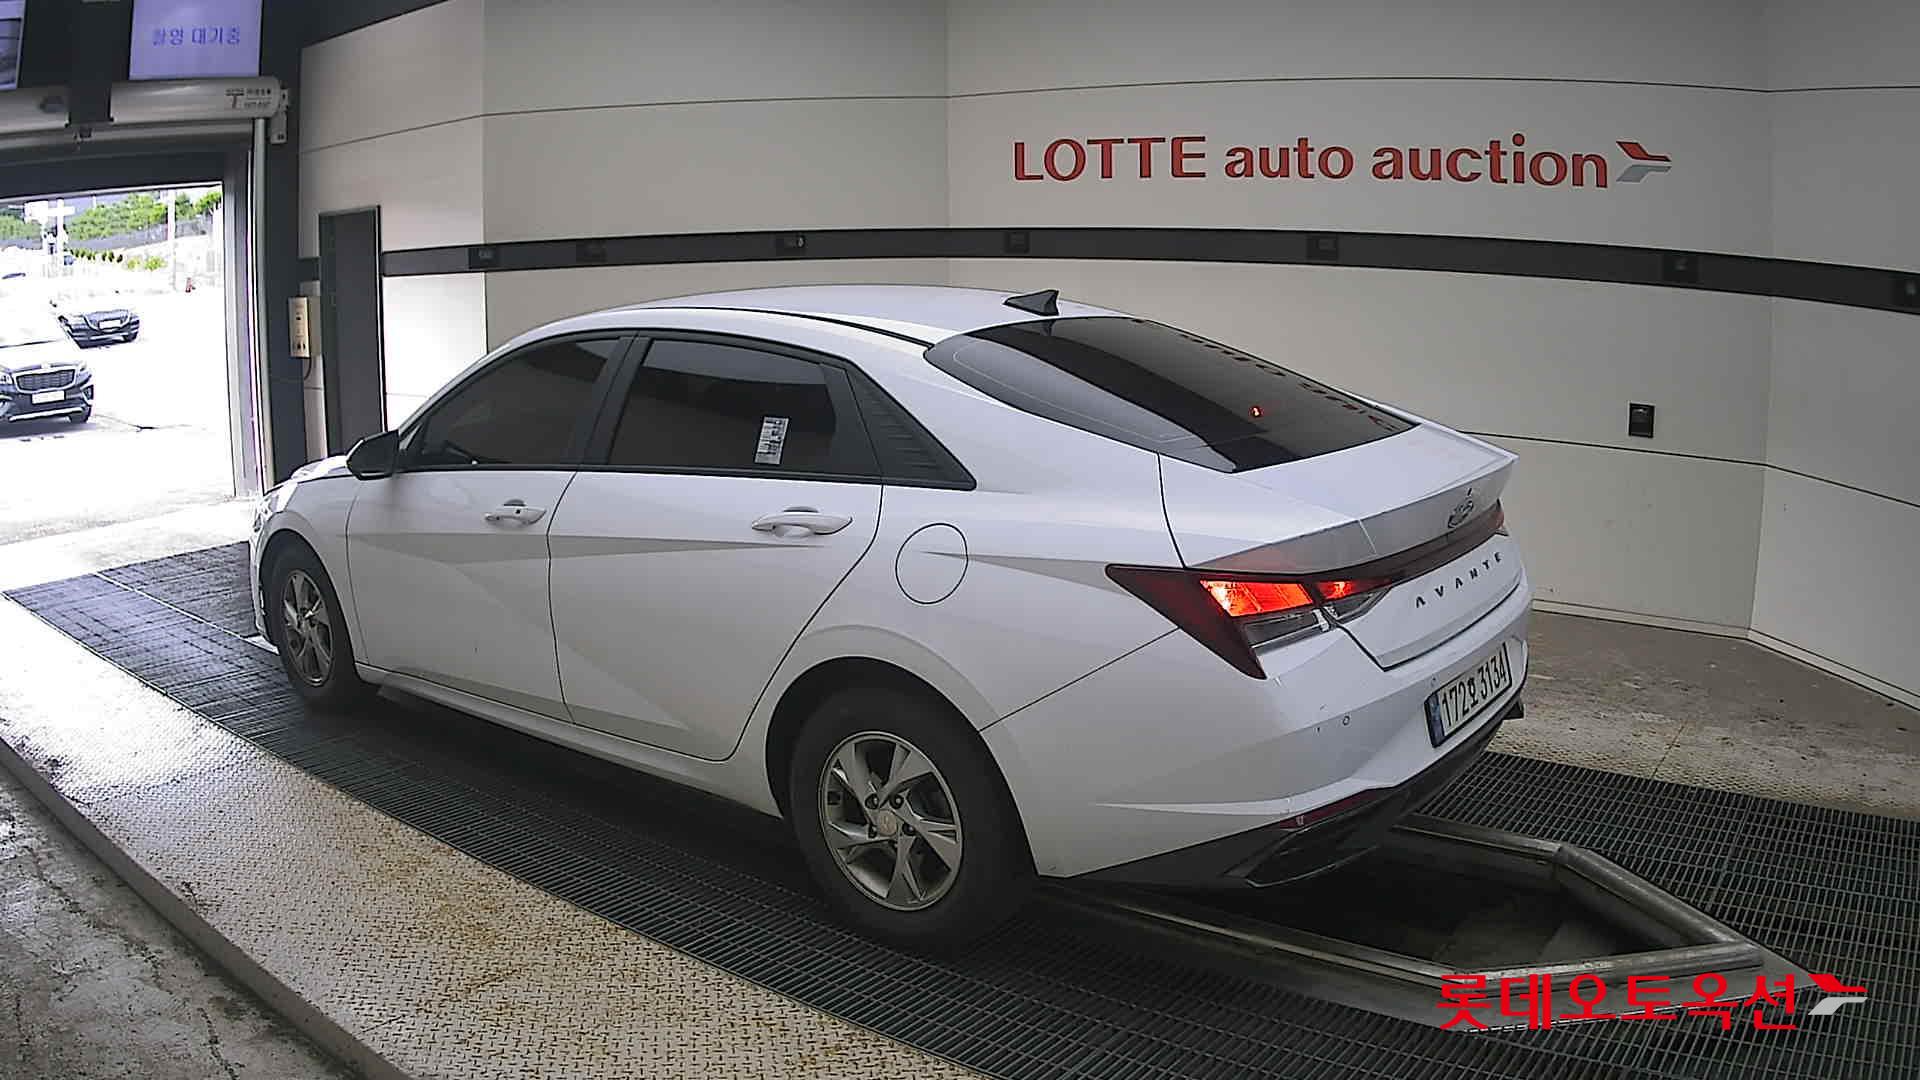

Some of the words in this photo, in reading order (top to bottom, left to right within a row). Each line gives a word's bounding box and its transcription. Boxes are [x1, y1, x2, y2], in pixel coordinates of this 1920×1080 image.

[1013, 136, 1206, 181] LOTTE
[1224, 137, 1354, 180] auto
[1371, 133, 1608, 189] auction
[1415, 551, 1503, 609] AVANTE
[1478, 651, 1507, 700] 3134
